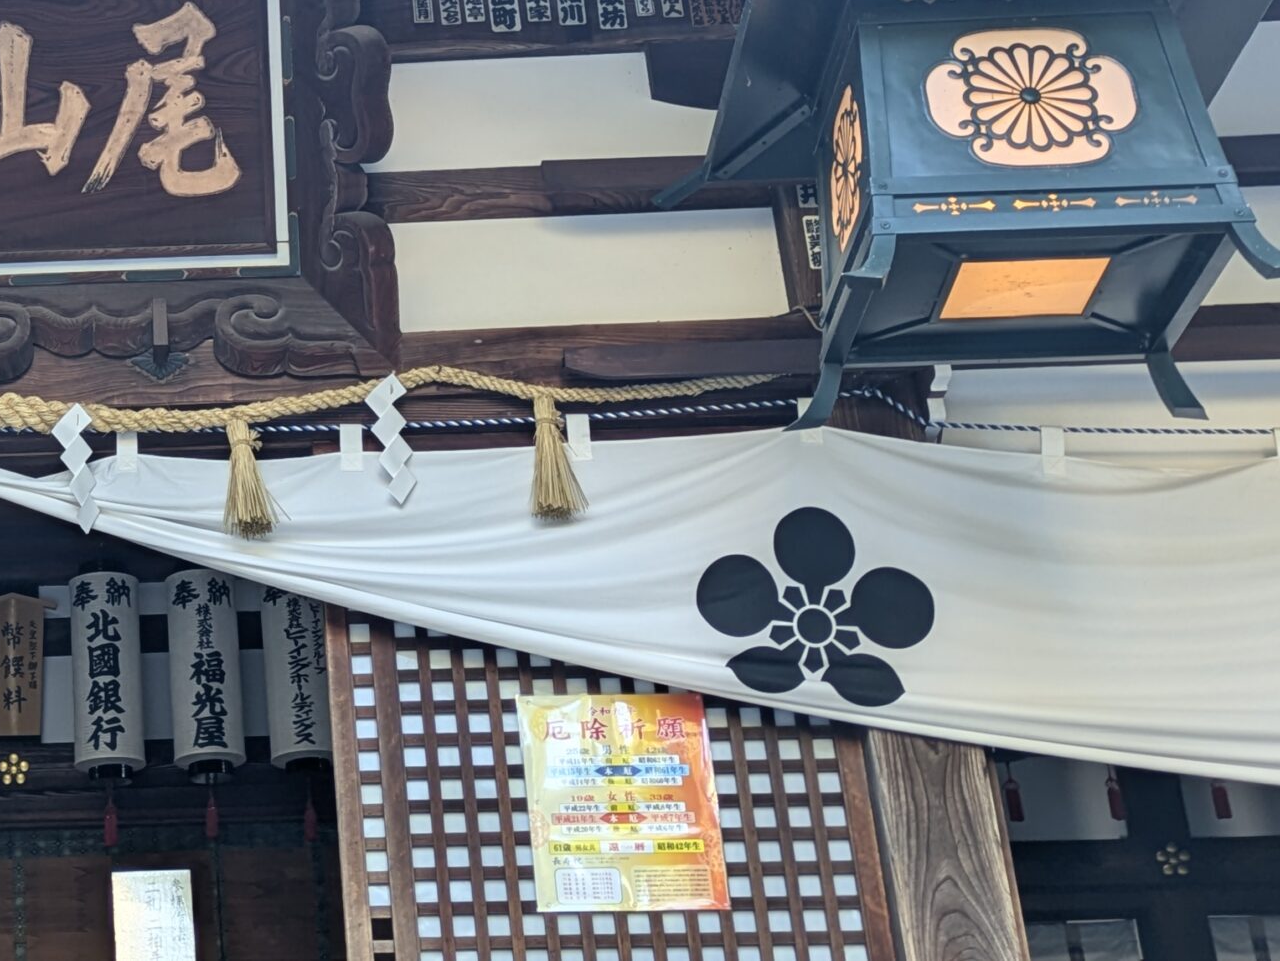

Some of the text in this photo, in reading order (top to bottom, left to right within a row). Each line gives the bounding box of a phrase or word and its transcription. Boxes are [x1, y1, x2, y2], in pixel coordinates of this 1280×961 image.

[73, 577, 131, 611] 奉納
[172, 577, 232, 609] 奉納
[195, 603, 214, 650] 株式会社
[86, 609, 126, 751] 北國銀行
[189, 651, 228, 749] 福光屋
[543, 717, 686, 741] 厄除祈願
